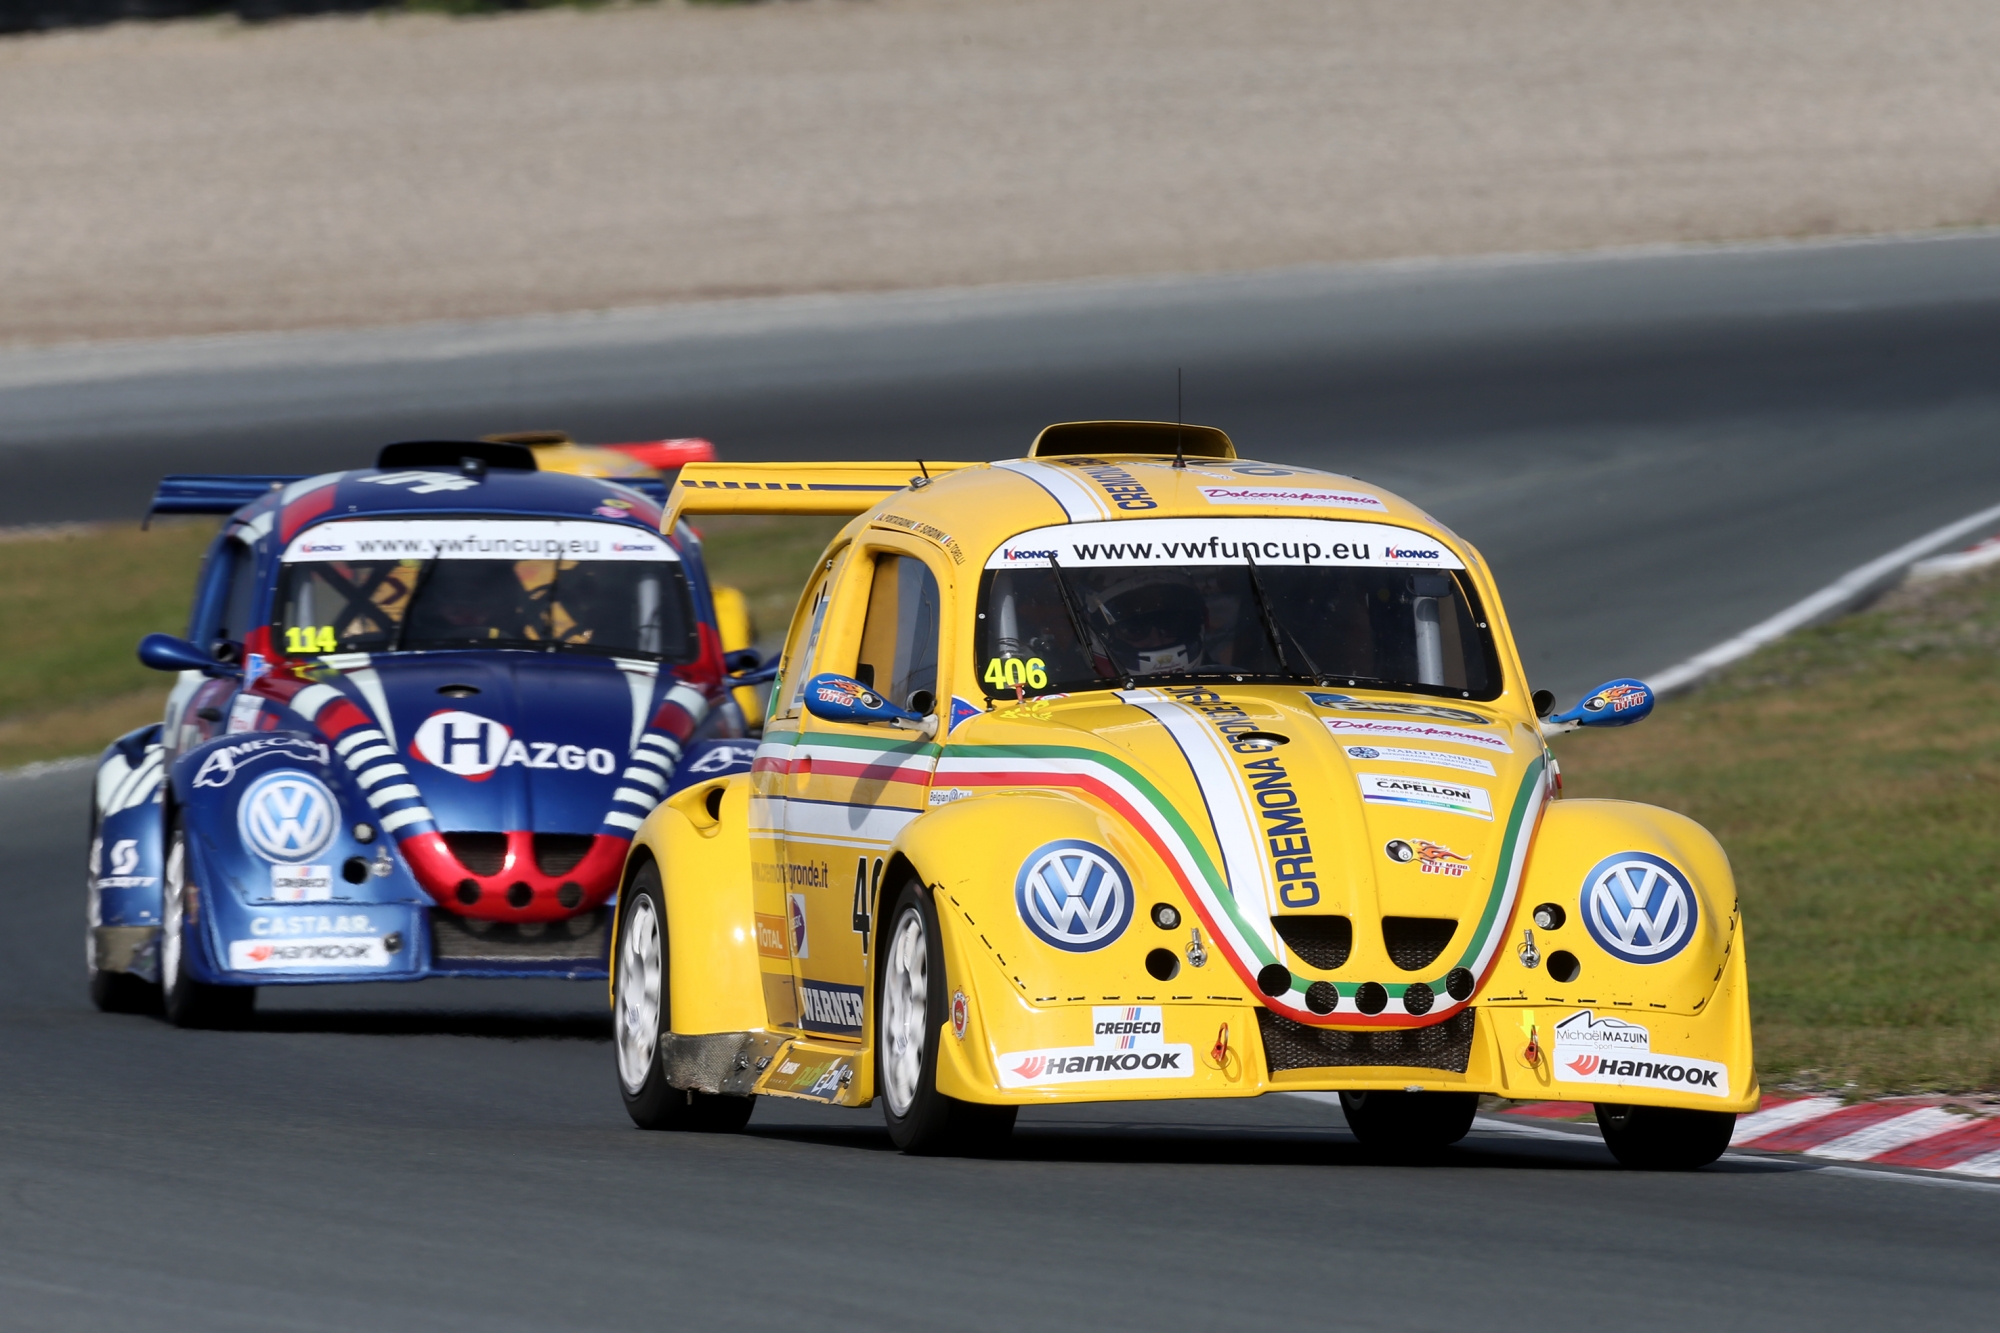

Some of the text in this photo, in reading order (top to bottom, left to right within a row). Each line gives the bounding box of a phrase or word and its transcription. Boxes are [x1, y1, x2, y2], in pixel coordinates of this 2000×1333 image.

[1003, 545, 1058, 560] KRONOS
[1072, 535, 1371, 564] www.vwfuncup.eu
[1385, 544, 1440, 559] KRONOS
[285, 626, 337, 653] 114
[984, 657, 1048, 690] 406
[1327, 720, 1505, 746] Dolcerisparmio
[442, 722, 616, 775] HAZGO
[1376, 781, 1472, 800] CAPELLONI
[1243, 756, 1320, 908] CREMONA
[757, 922, 783, 949] TOTAL
[799, 985, 865, 1027] WARNER
[1095, 1022, 1161, 1035] CREDECO
[1602, 1031, 1648, 1044] MAZUIN
[1592, 1042, 1613, 1051] Sport
[1045, 1052, 1182, 1075] HANKOOK
[1598, 1055, 1719, 1088] HANKOOK
